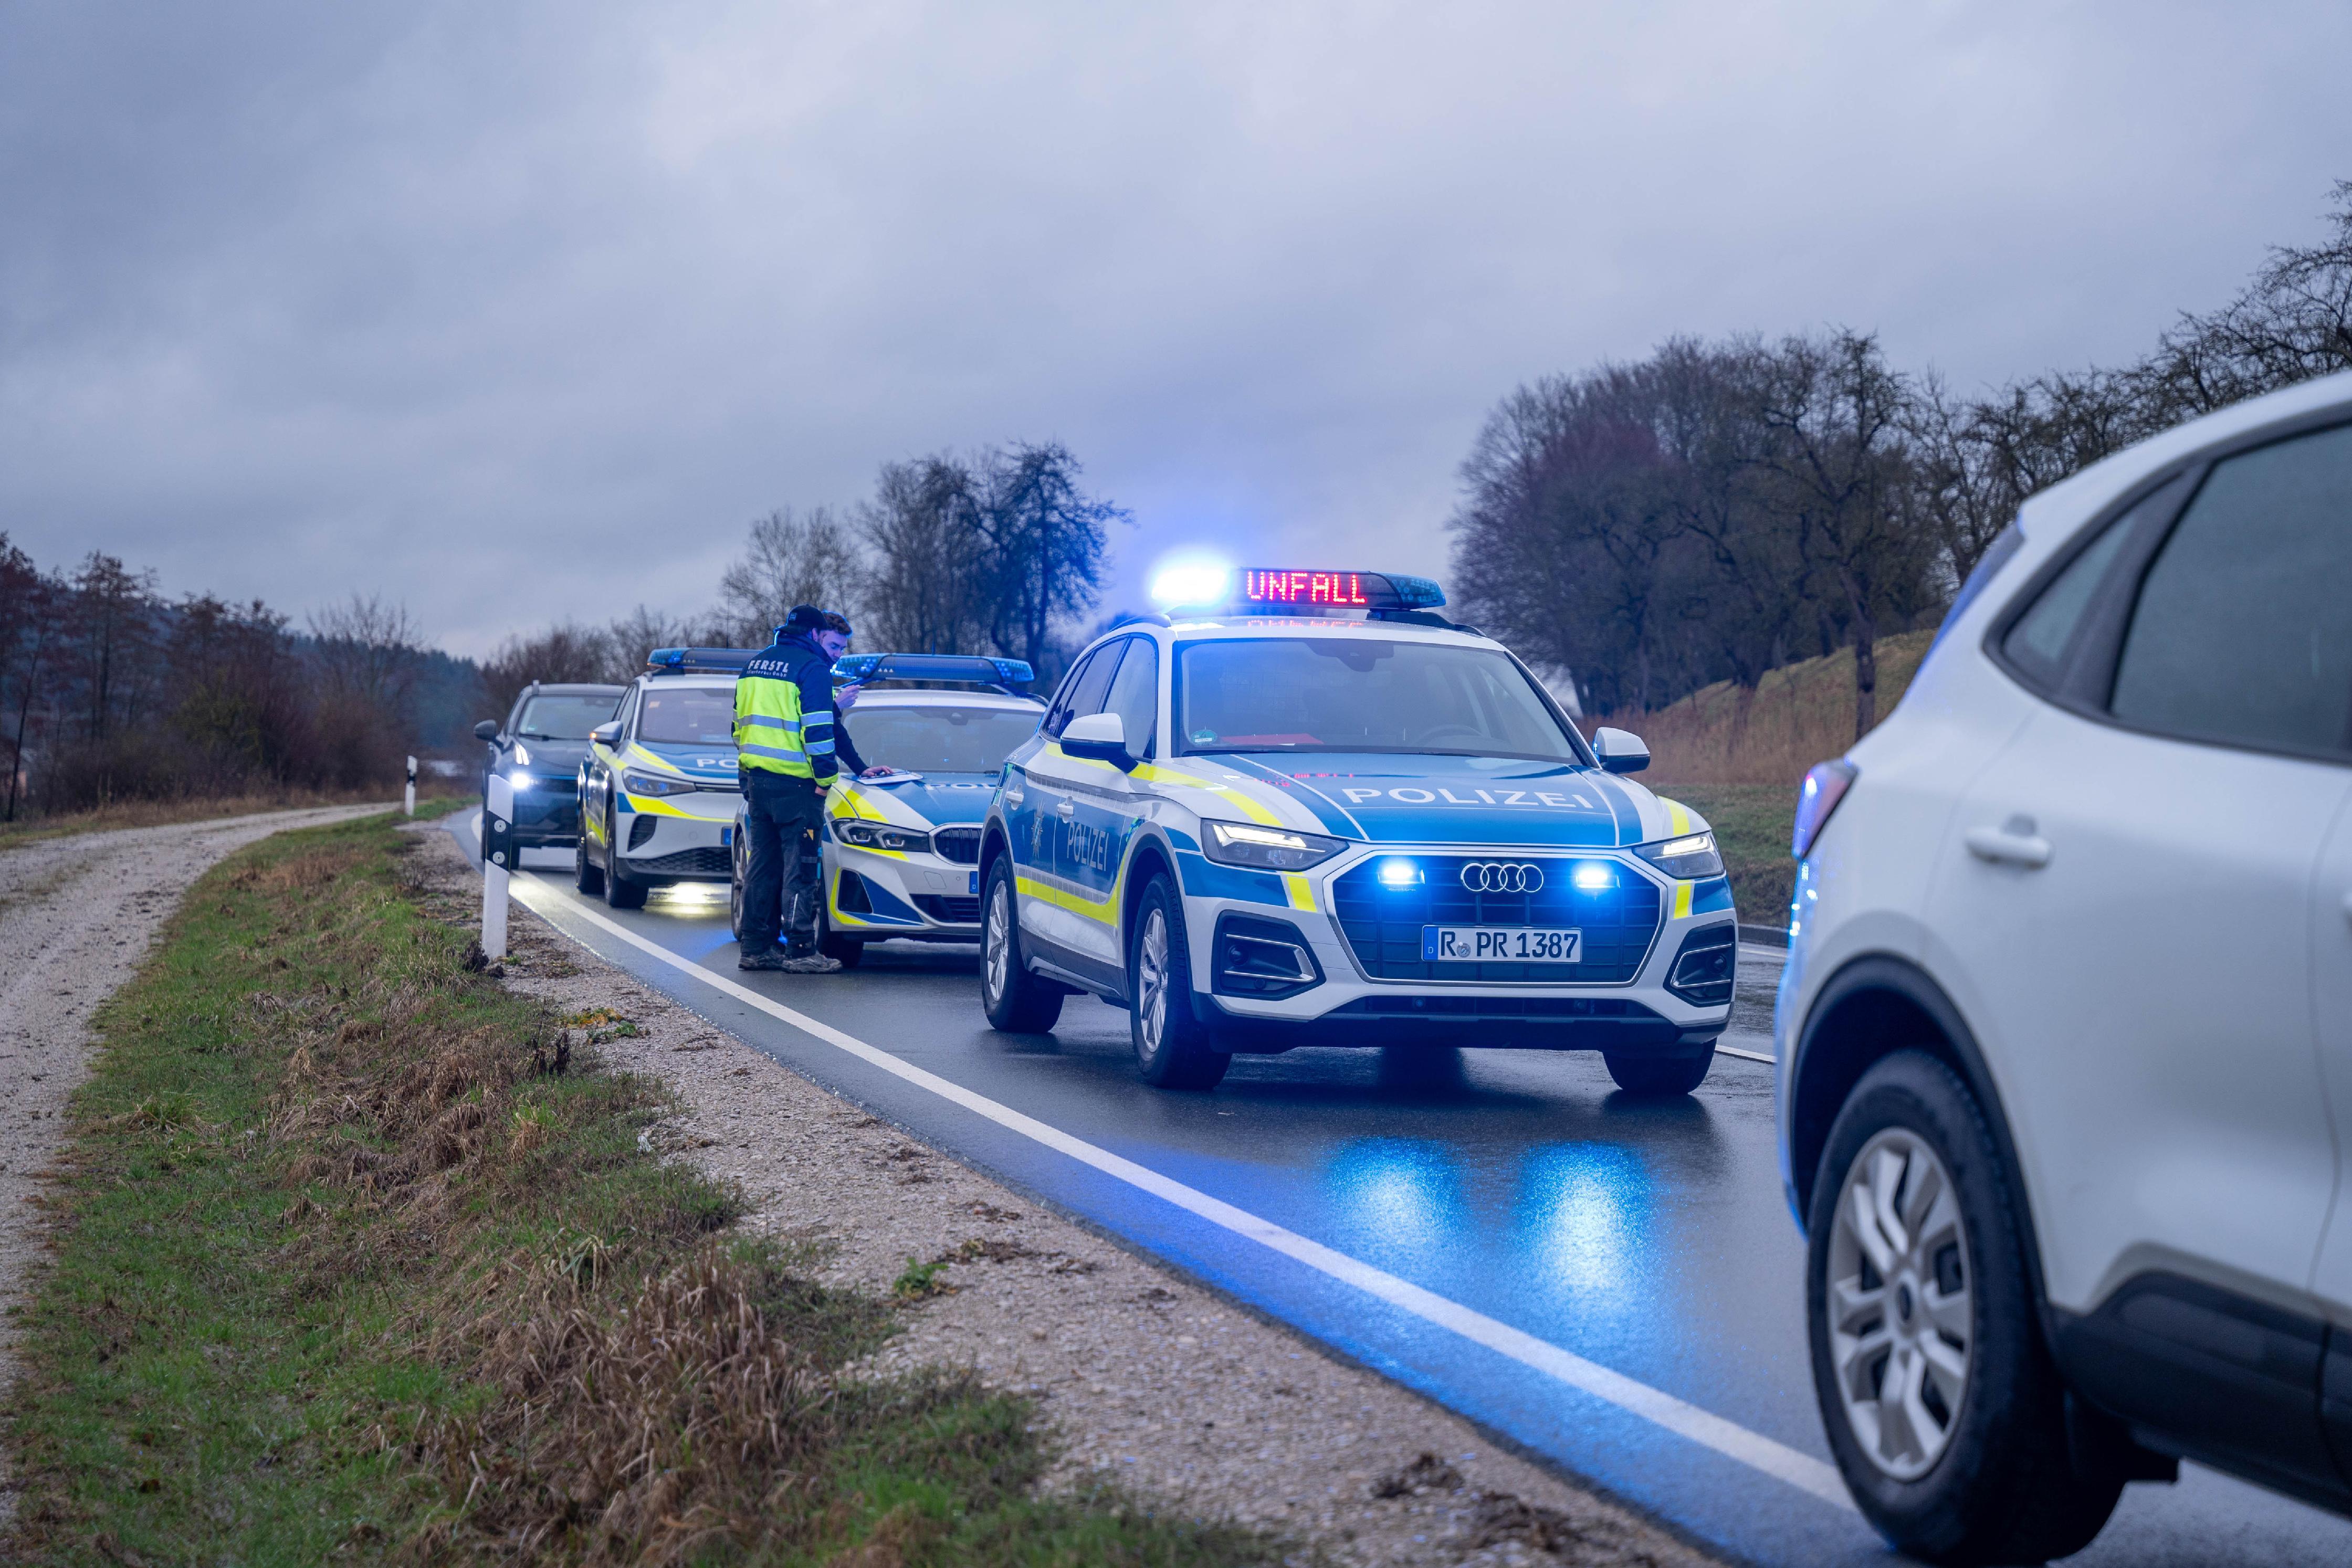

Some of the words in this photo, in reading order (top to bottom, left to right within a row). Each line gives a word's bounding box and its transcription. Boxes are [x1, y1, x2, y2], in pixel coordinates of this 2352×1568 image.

[1247, 570, 1368, 604] UNFALL
[748, 660, 789, 673] FERSTL
[1341, 788, 1594, 808] POLIZEI
[1066, 822, 1109, 871] POLIZEI
[1441, 931, 1456, 956] R
[1476, 931, 1508, 957] PR
[1515, 932, 1578, 959] 1387
